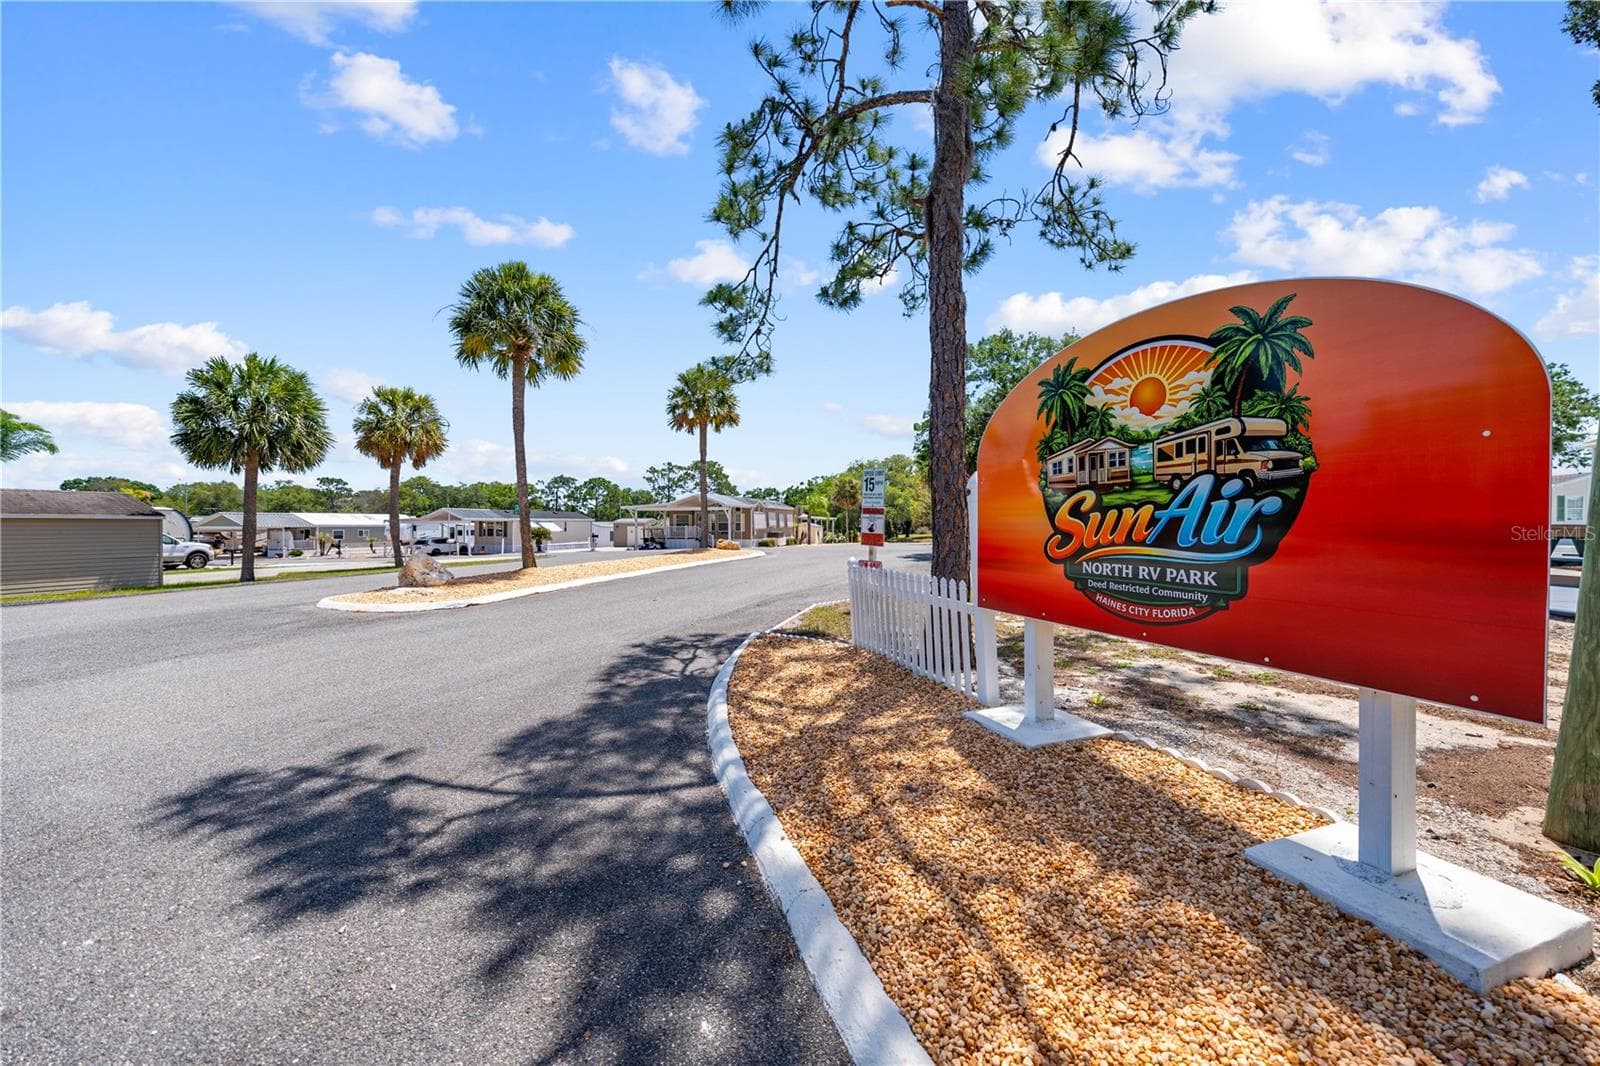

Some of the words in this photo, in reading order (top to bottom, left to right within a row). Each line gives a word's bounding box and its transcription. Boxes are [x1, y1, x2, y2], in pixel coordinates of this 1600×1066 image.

[864, 477, 875, 492] 15
[1047, 473, 1283, 559] SunAir
[1082, 561, 1133, 578] NORTH
[1138, 566, 1161, 581] RV
[1165, 569, 1218, 587] PARK
[1087, 579, 1107, 590] Deed
[1109, 581, 1150, 595] Restricted
[1152, 586, 1209, 604] Community
[1095, 592, 1127, 613] HAINES
[1128, 605, 1150, 617] CITY
[1152, 606, 1196, 619] FLORIDA
